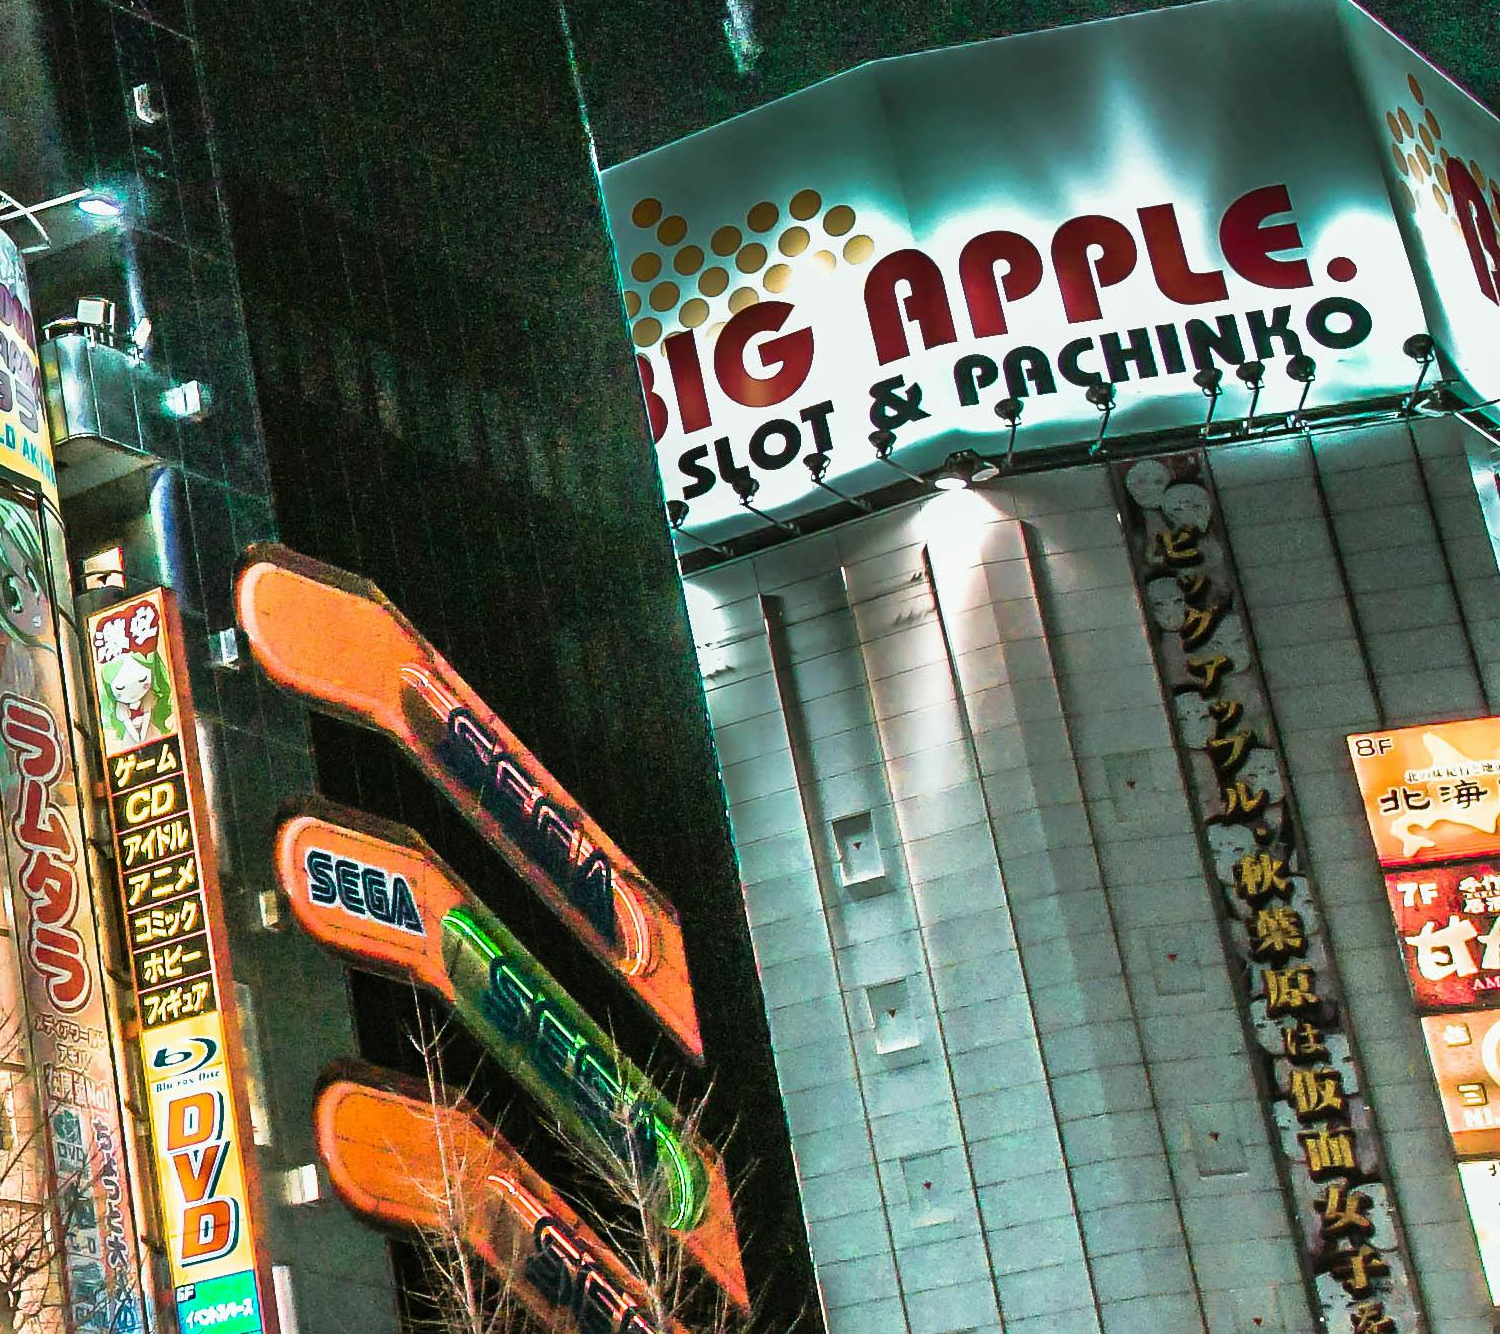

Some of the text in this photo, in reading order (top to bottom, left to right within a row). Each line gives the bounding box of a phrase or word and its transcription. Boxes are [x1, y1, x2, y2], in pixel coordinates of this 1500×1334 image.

[678, 295, 1374, 503] SLOT & PACHINKO
[93, 601, 161, 661] 激安
[114, 746, 178, 781] ゲーム
[1354, 738, 1394, 759] 8F
[124, 781, 177, 823] CD
[0, 693, 93, 1014] ラムタラ
[122, 823, 190, 863] アイドル
[129, 865, 195, 905] アニメ
[306, 850, 425, 935] SEGA
[1396, 881, 1440, 910] 7F
[134, 906, 198, 943] コミック
[142, 947, 200, 980] ホビー
[145, 982, 211, 1025] フィギュア
[165, 1092, 241, 1266] DVD
